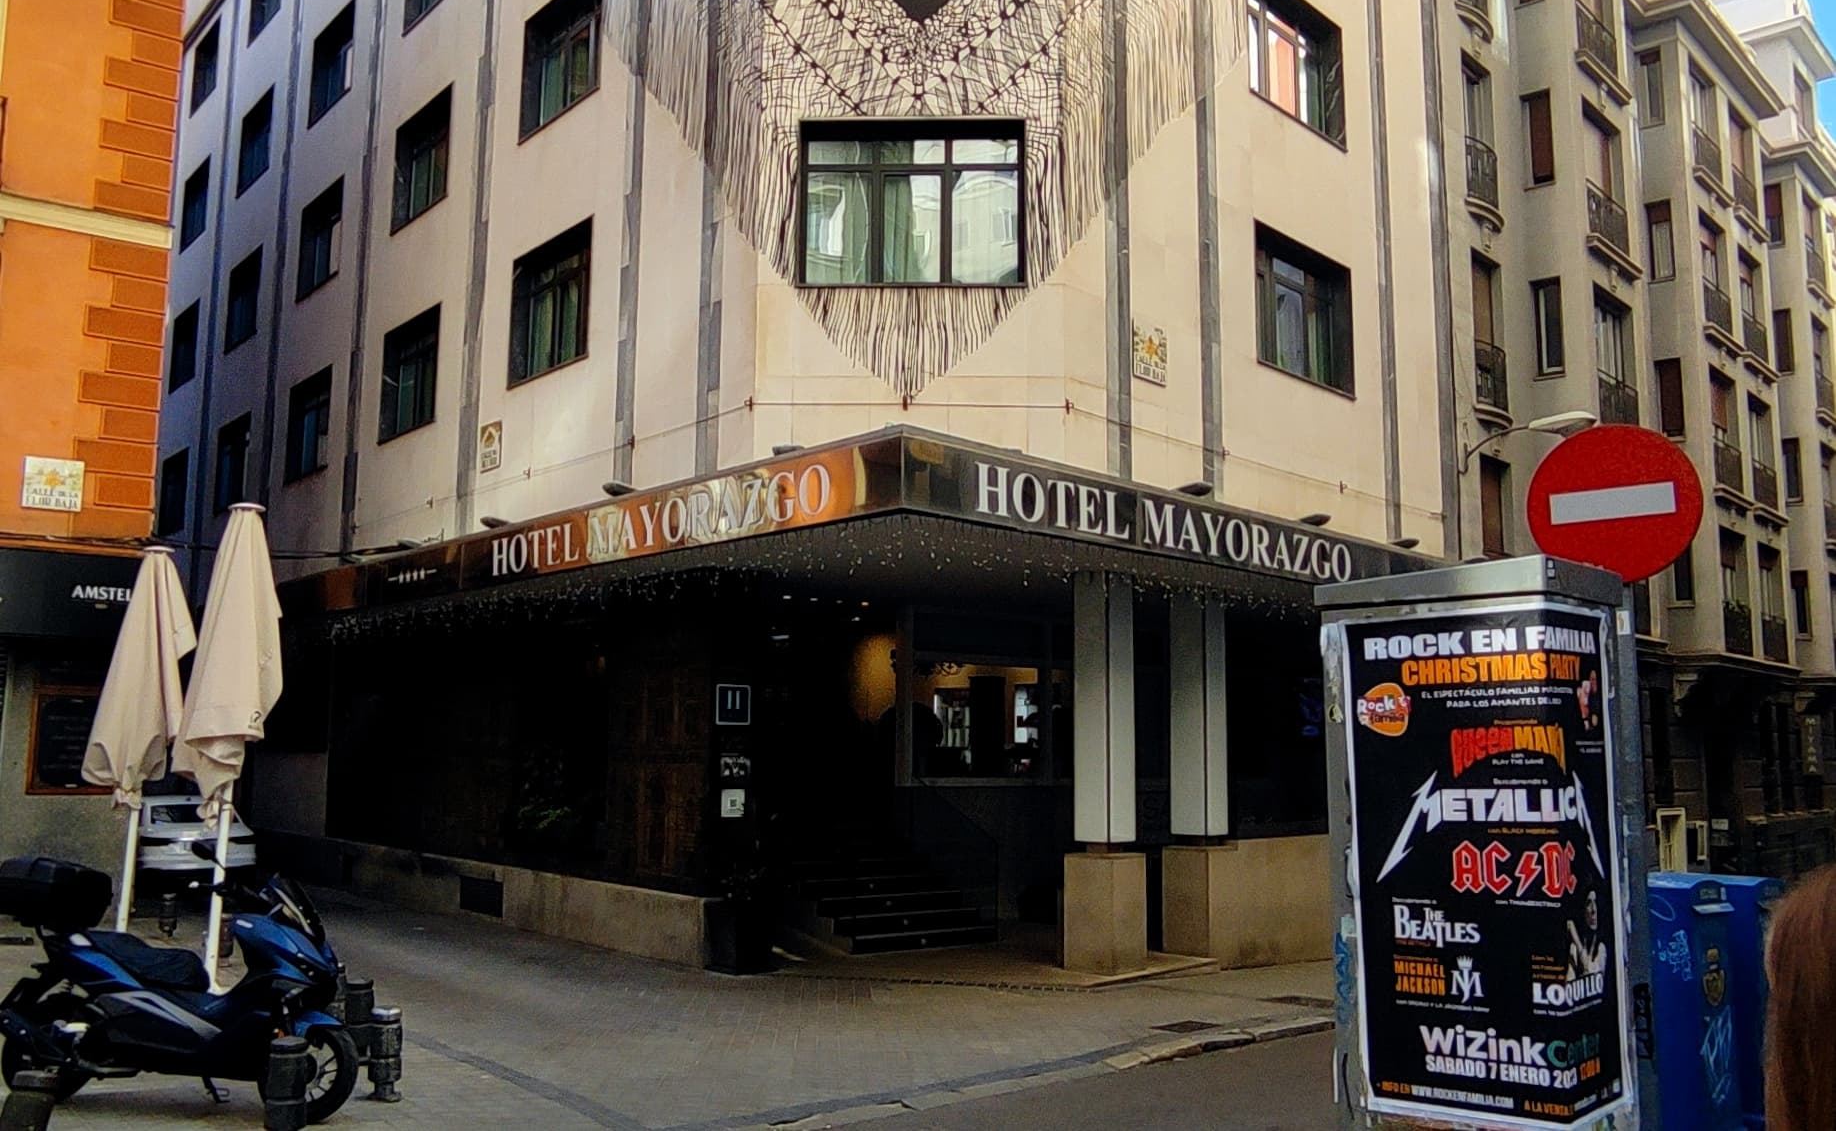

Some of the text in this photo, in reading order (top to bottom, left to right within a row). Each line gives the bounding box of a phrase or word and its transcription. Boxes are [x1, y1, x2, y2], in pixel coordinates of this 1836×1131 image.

[492, 463, 831, 577] HOTEL MAYORAZGO
[975, 460, 1352, 583] HOTEL MAYORAZGO
[71, 584, 131, 602] AMSTEL
[1363, 625, 1596, 661] ROCK EN FAMILIA
[1401, 652, 1581, 686] CHRISTMAS PARTY
[1377, 770, 1604, 883] METALLICA
[1393, 904, 1481, 948] BEATLES
[1423, 907, 1445, 921] THE
[1394, 960, 1445, 978] MICHAEL
[1395, 975, 1446, 996] JACKSON
[1532, 973, 1604, 1007] LOQUILLO
[1419, 1025, 1547, 1067] WiZink
[1425, 1055, 1486, 1079] SABADO
[1488, 1062, 1499, 1080] 7
[1500, 1064, 1550, 1087] ENERO
